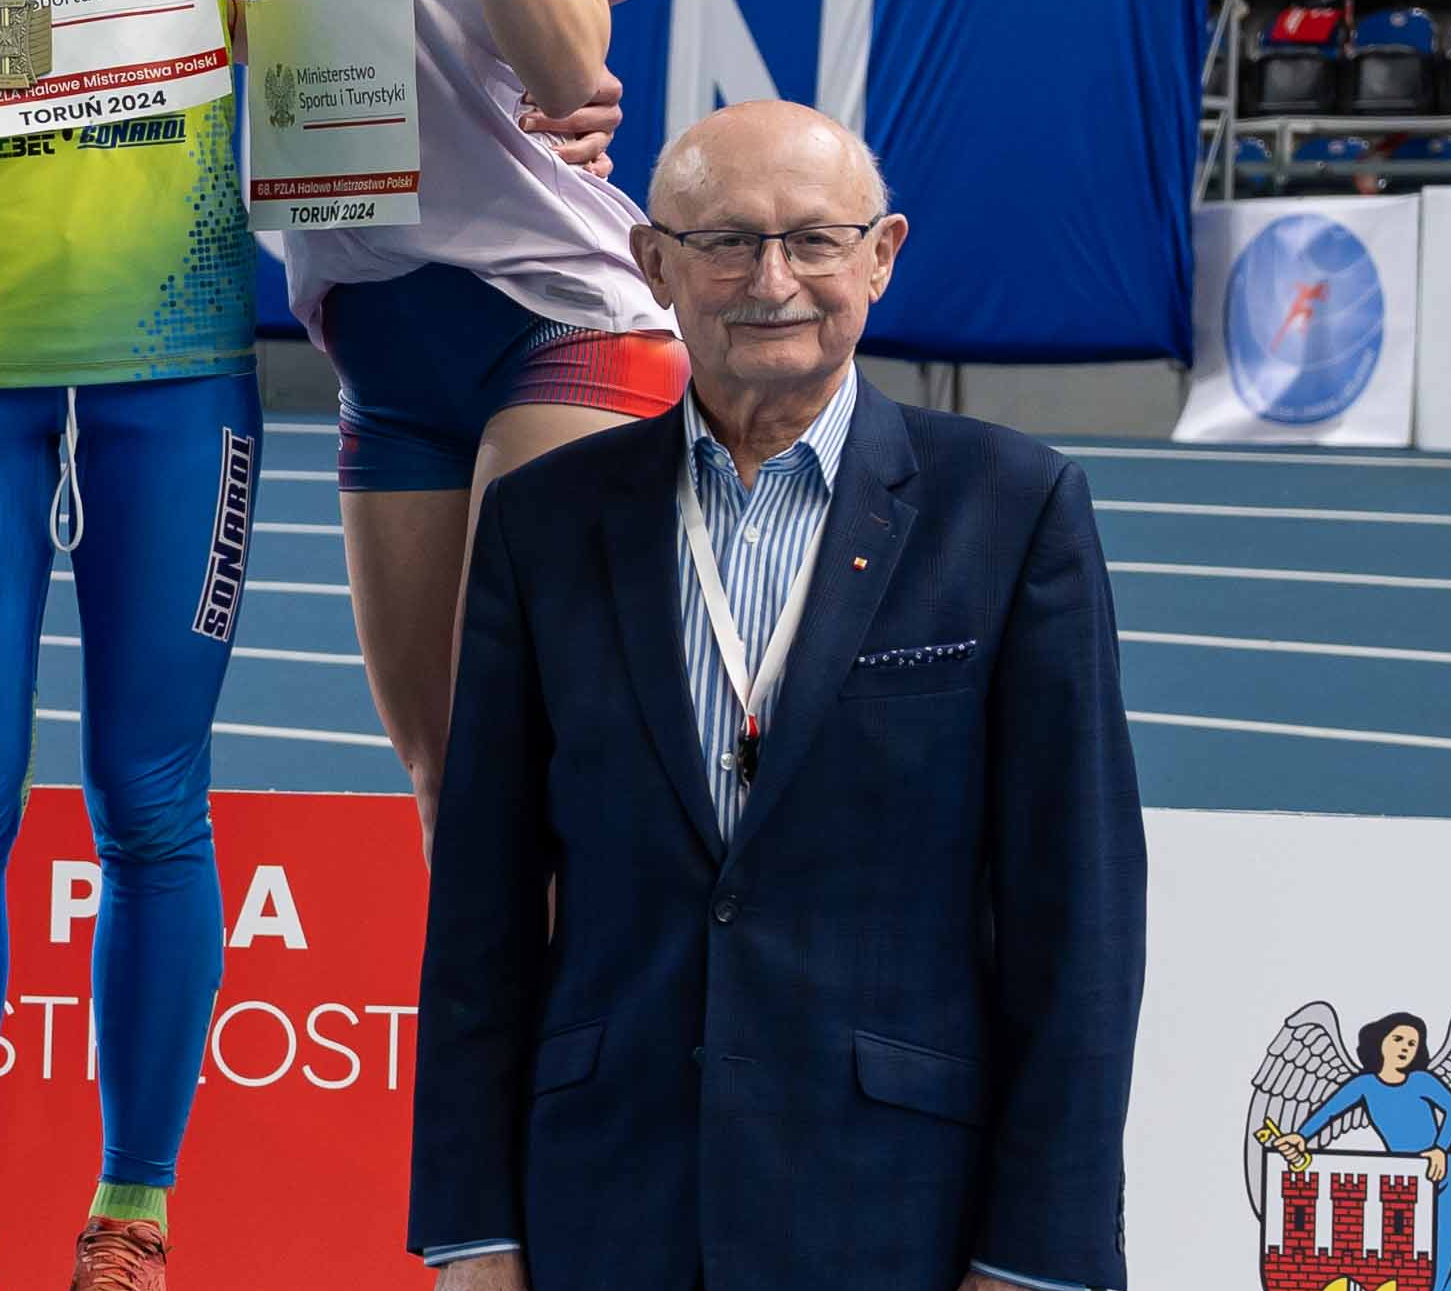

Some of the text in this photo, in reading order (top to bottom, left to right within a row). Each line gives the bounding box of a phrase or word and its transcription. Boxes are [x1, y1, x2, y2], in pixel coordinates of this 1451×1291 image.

[83, 64, 173, 90] Mistrzostwa
[176, 53, 218, 75] Polski
[297, 63, 376, 86] Ministerstwo
[19, 89, 167, 126] TORUŃ 2024
[299, 89, 338, 112] Sportu
[348, 84, 406, 108] Turystyki
[257, 173, 414, 197] 68. PZLA Halowe Mistrzostwa Polski
[290, 201, 375, 225] TORUŃ 2024
[196, 430, 255, 642] SONAROL
[50, 859, 309, 949] PA
